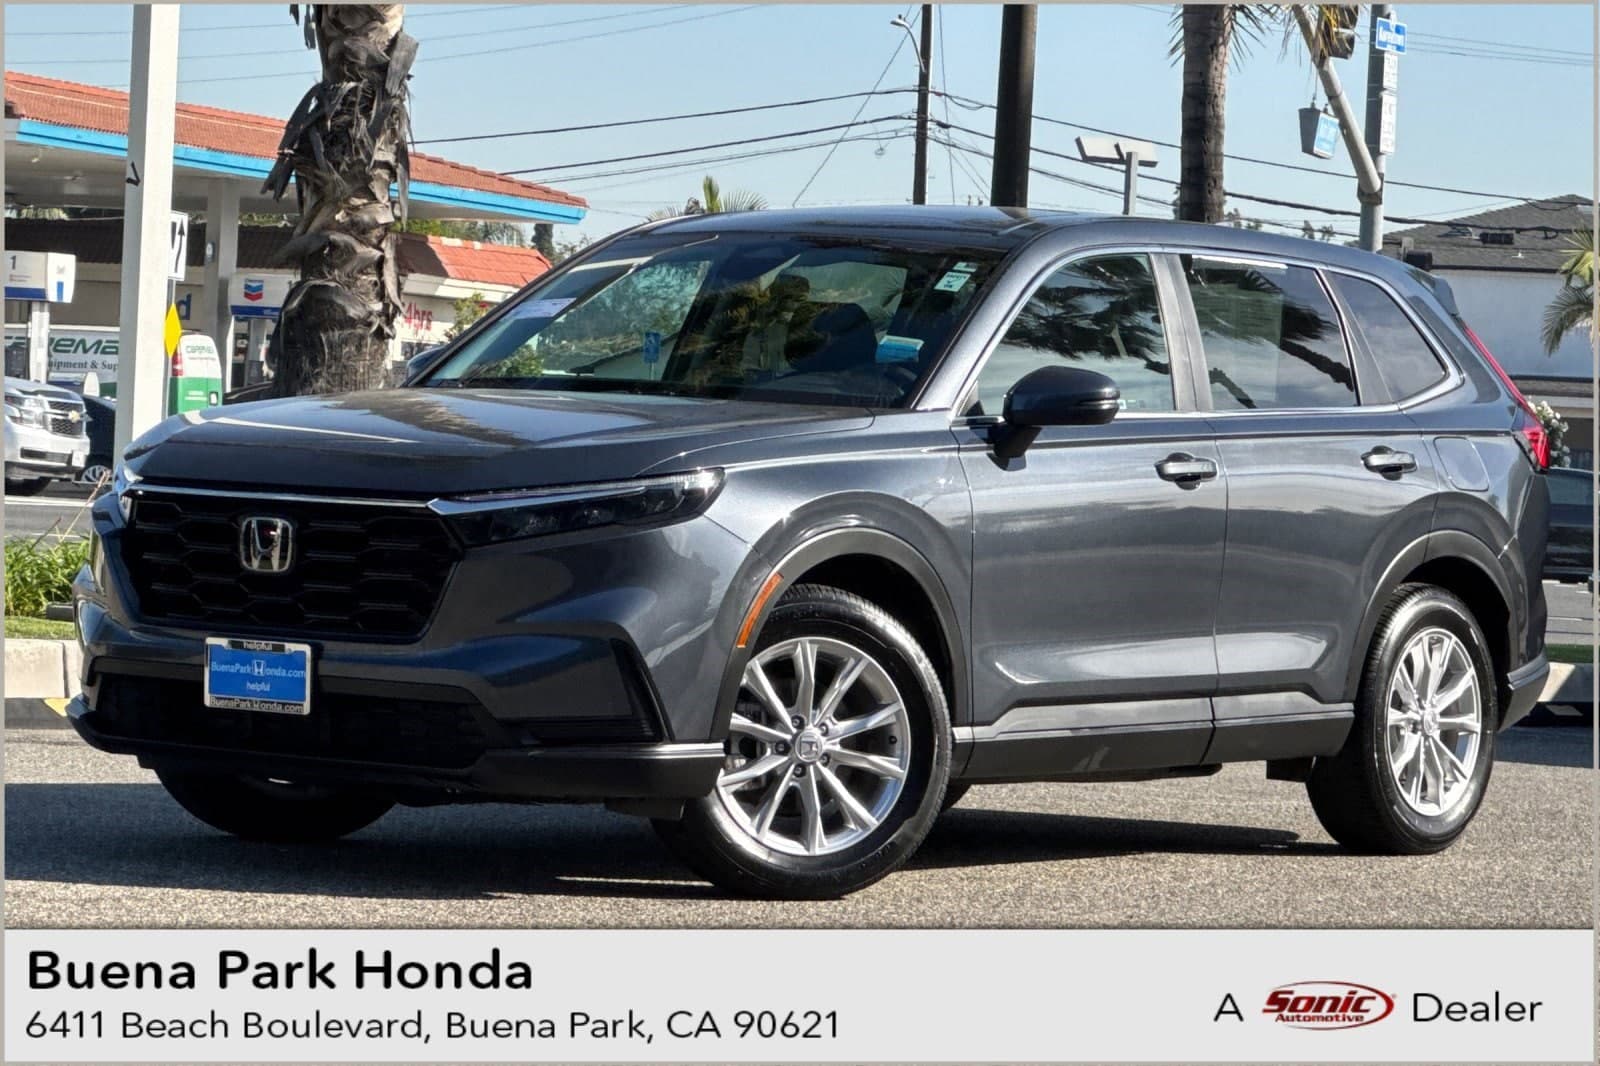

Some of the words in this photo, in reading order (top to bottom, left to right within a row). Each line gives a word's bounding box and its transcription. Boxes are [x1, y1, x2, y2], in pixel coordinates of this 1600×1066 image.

[10, 255, 17, 270] 1
[404, 302, 433, 331] 4hrs
[90, 360, 98, 369] &
[101, 361, 118, 371] Sup
[246, 681, 271, 693] helpful
